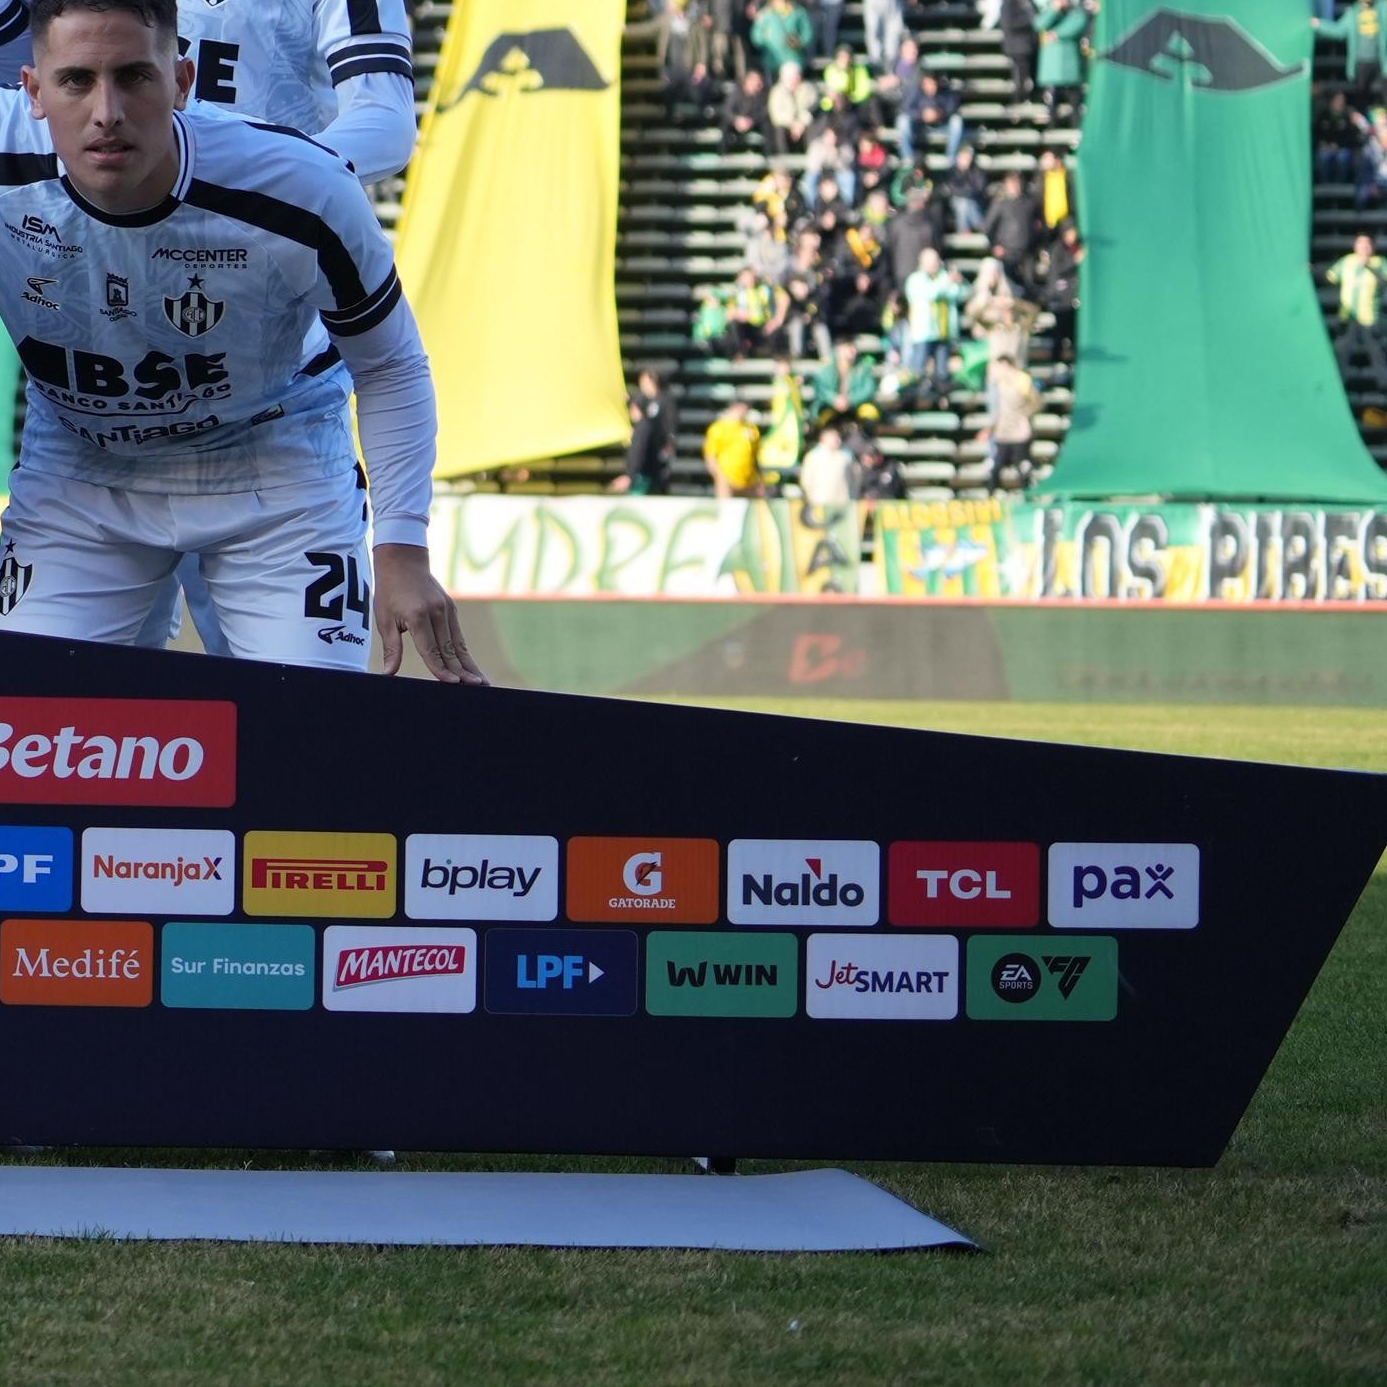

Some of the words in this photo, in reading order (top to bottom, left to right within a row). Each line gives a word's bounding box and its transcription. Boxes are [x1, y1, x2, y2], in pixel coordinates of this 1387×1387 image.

[22, 214, 62, 243] ISM
[44, 239, 83, 253] SANTIAGO
[151, 248, 248, 262] MCCENTER
[20, 292, 60, 310] Adhoc
[74, 351, 228, 400] BSE
[34, 381, 108, 409] BANCO
[304, 552, 369, 630] 24
[335, 631, 365, 646] Adhoc
[252, 857, 388, 890] PIRELLI
[421, 859, 541, 896] bplay
[743, 859, 864, 907] Naldo
[917, 869, 1011, 899] TCL
[1073, 864, 1174, 908] pax
[609, 898, 675, 908] GATORADE
[13, 948, 139, 978] Medifé
[172, 957, 206, 973] Sur
[213, 958, 305, 976] Finanzas
[339, 948, 458, 981] MANTECOL
[517, 955, 583, 989] LPF
[713, 964, 777, 986] WIN
[1001, 965, 1031, 980] EA
[999, 981, 1033, 989] SPORTS
